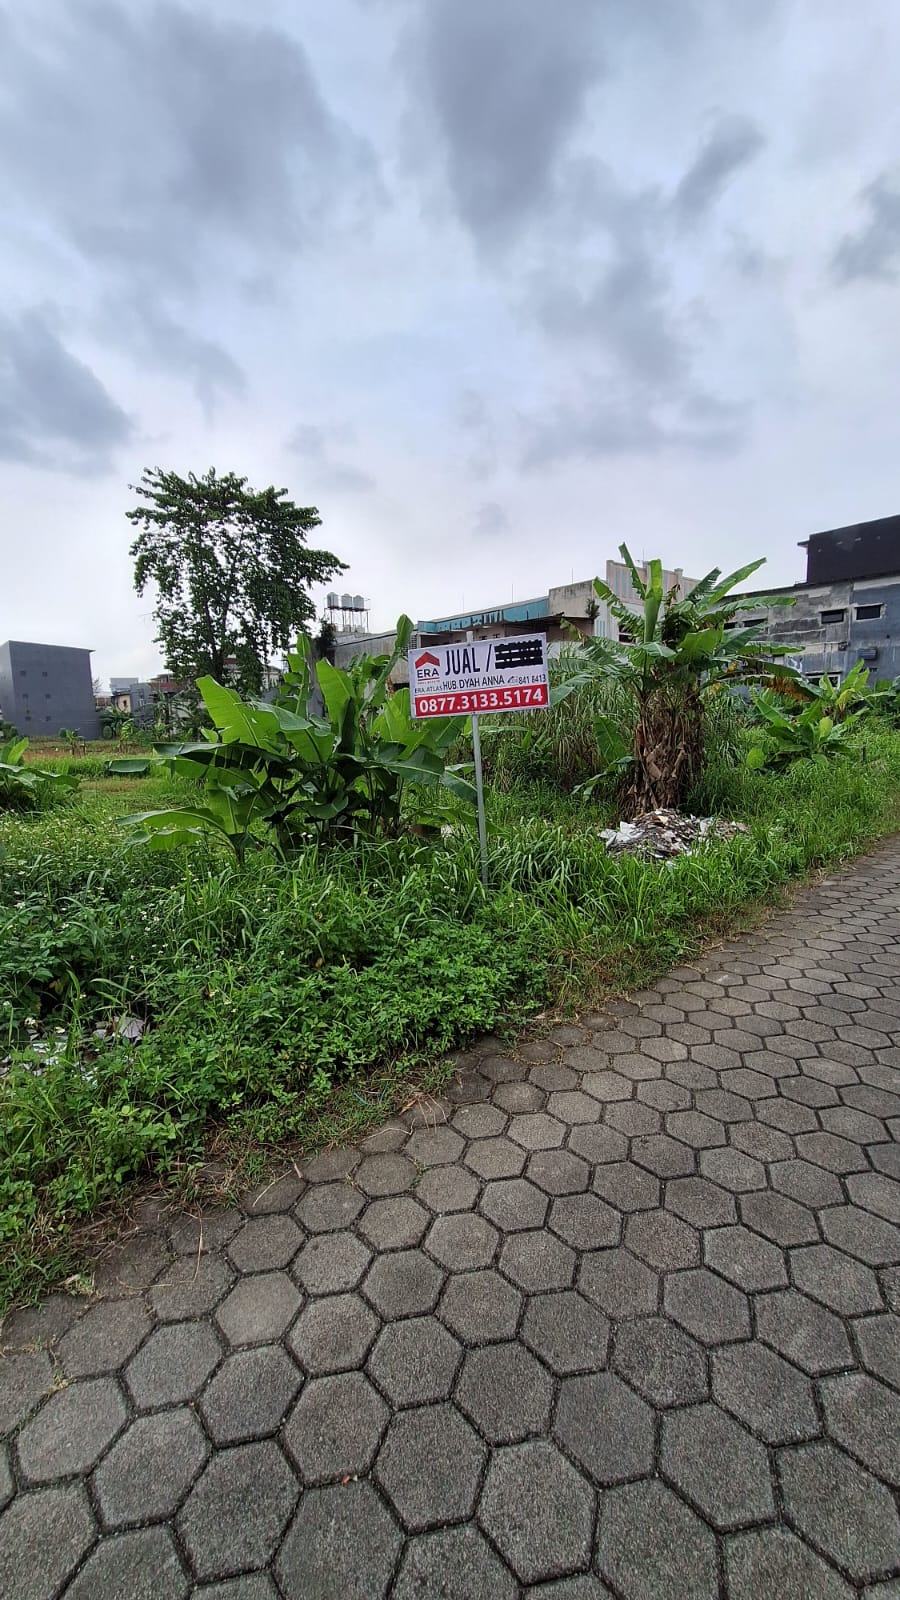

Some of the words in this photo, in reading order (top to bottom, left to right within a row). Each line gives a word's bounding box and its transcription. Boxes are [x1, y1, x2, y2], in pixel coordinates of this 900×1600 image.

[445, 647, 480, 676] JUAL
[417, 668, 440, 678] ERA
[460, 678, 480, 688] DYAH
[482, 675, 505, 686] ANNA
[420, 688, 543, 713] 0877.3133.5174
